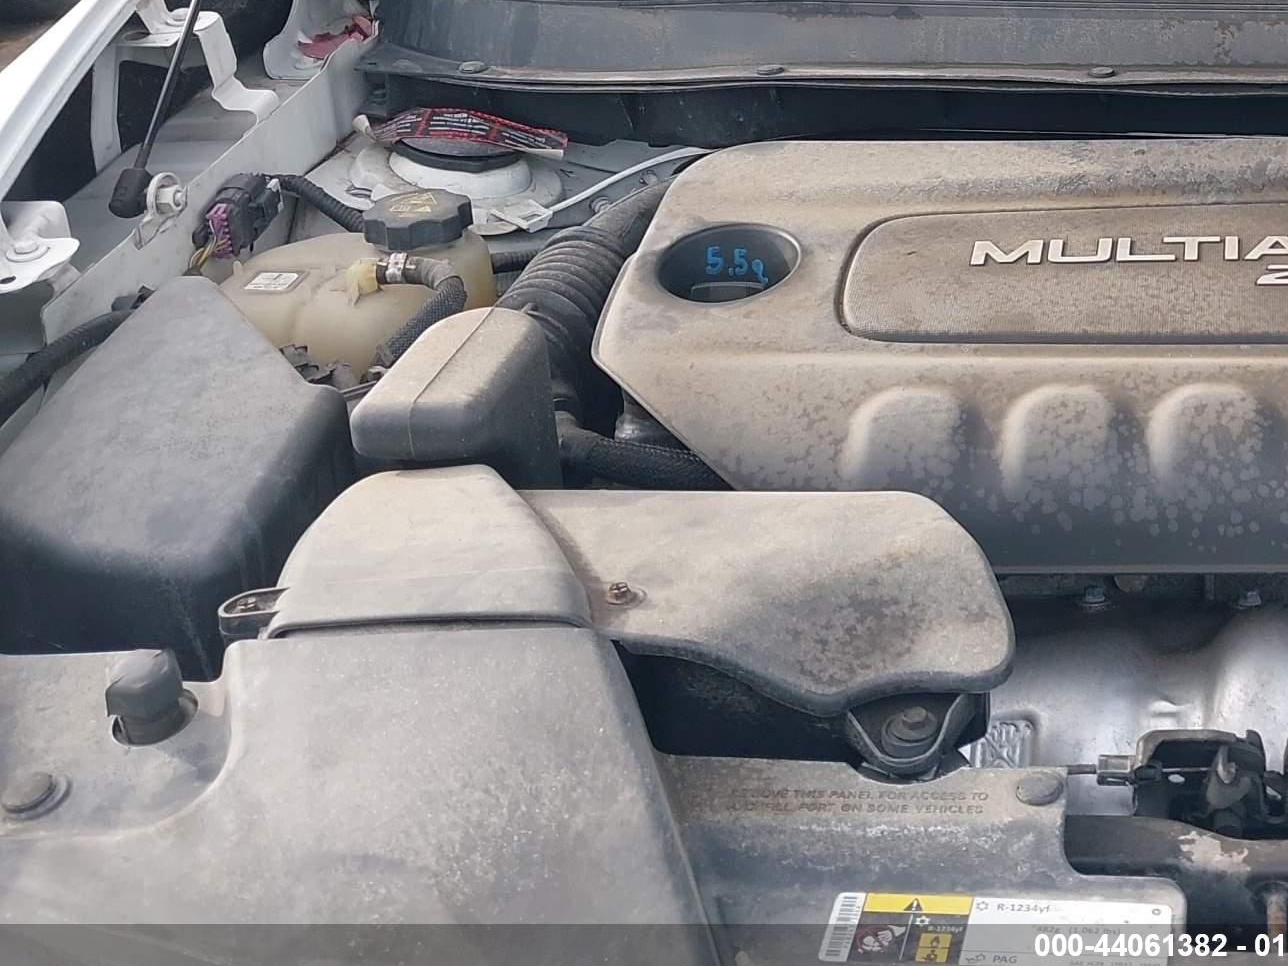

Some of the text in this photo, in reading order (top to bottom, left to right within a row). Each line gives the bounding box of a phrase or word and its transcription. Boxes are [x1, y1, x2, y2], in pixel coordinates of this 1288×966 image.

[828, 789, 873, 800] PANEL
[878, 790, 908, 801] FOR
[970, 792, 989, 802] TO
[840, 803, 863, 813] ON
[866, 803, 909, 814] SOME
[914, 804, 985, 815] VEHICLES
[996, 902, 1051, 914] R-1234yf
[992, 954, 1018, 964] PAG
